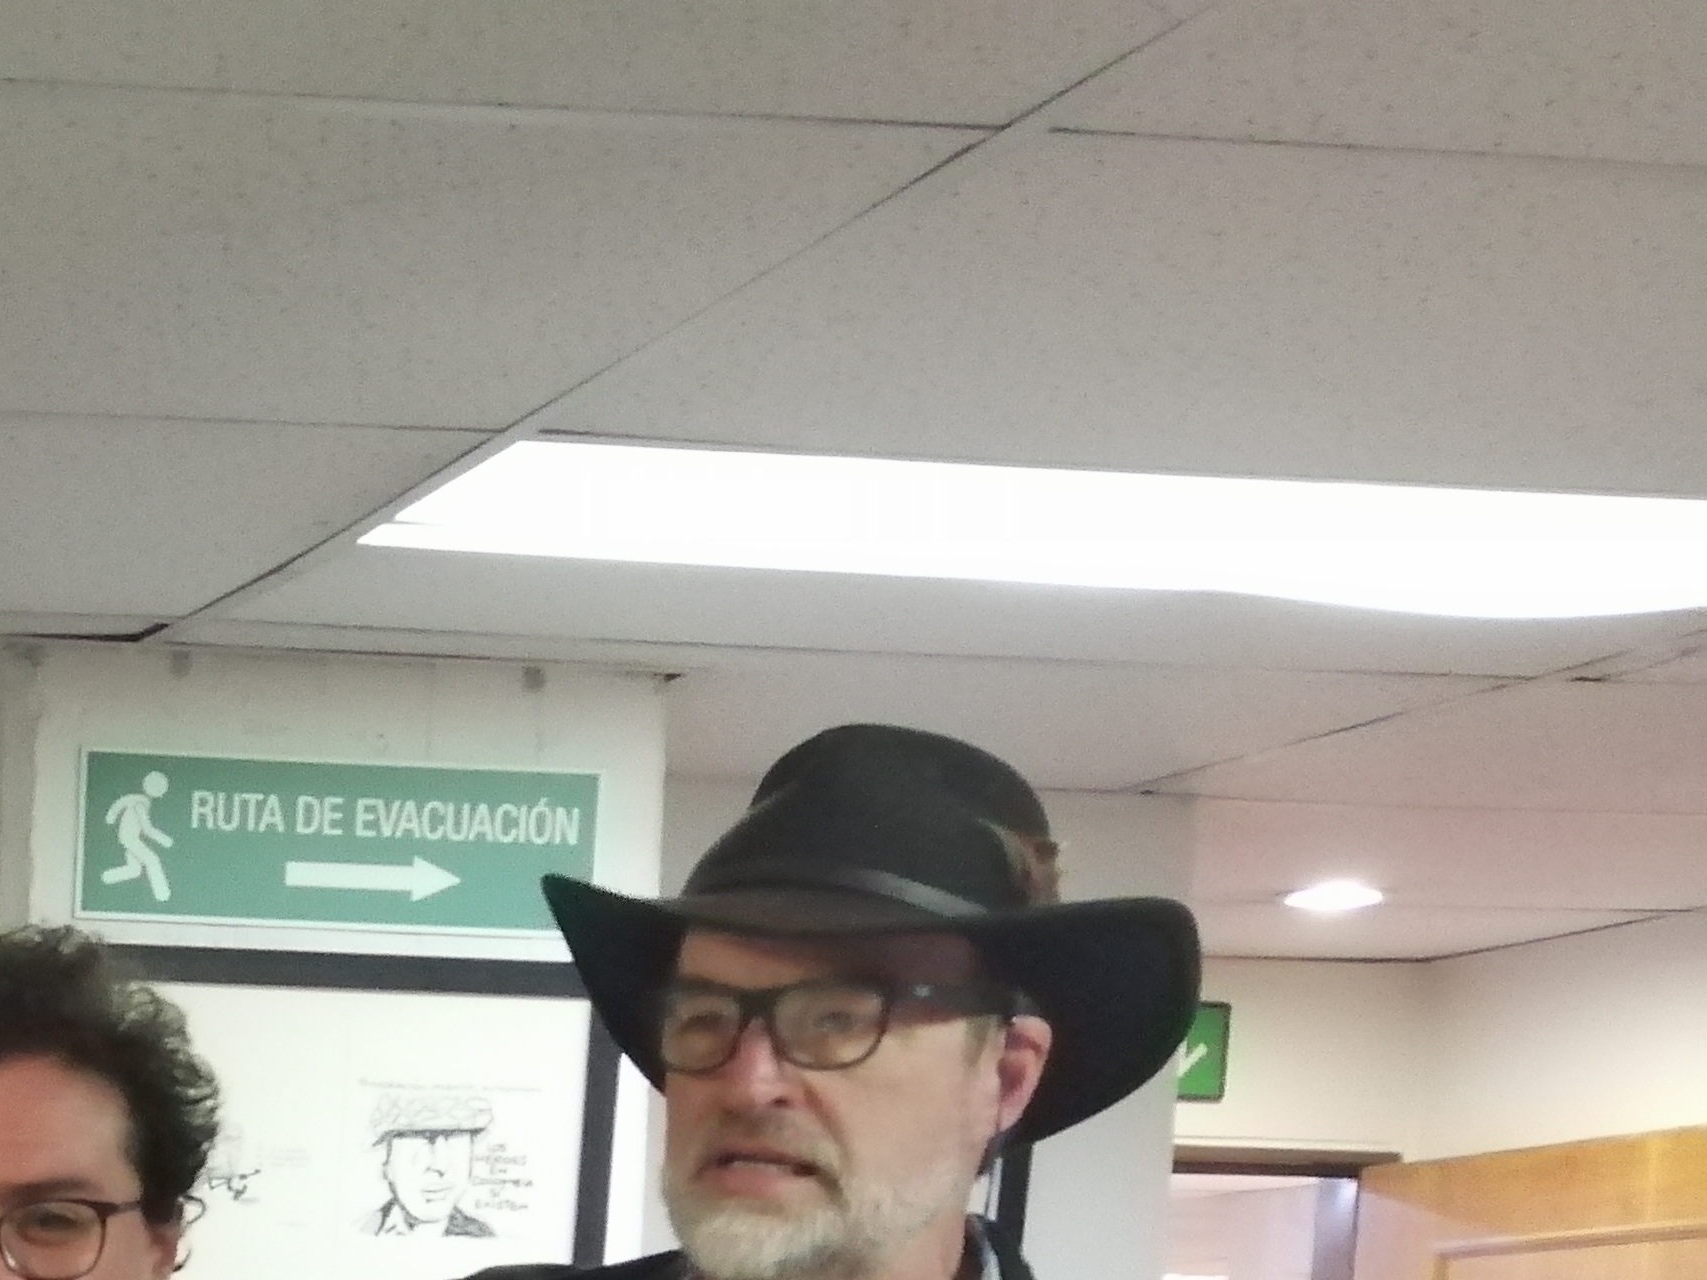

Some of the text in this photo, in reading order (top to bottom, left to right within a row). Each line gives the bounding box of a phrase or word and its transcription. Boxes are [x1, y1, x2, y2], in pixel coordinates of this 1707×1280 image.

[190, 790, 581, 846] RUTA DE EVACUACIÓN
